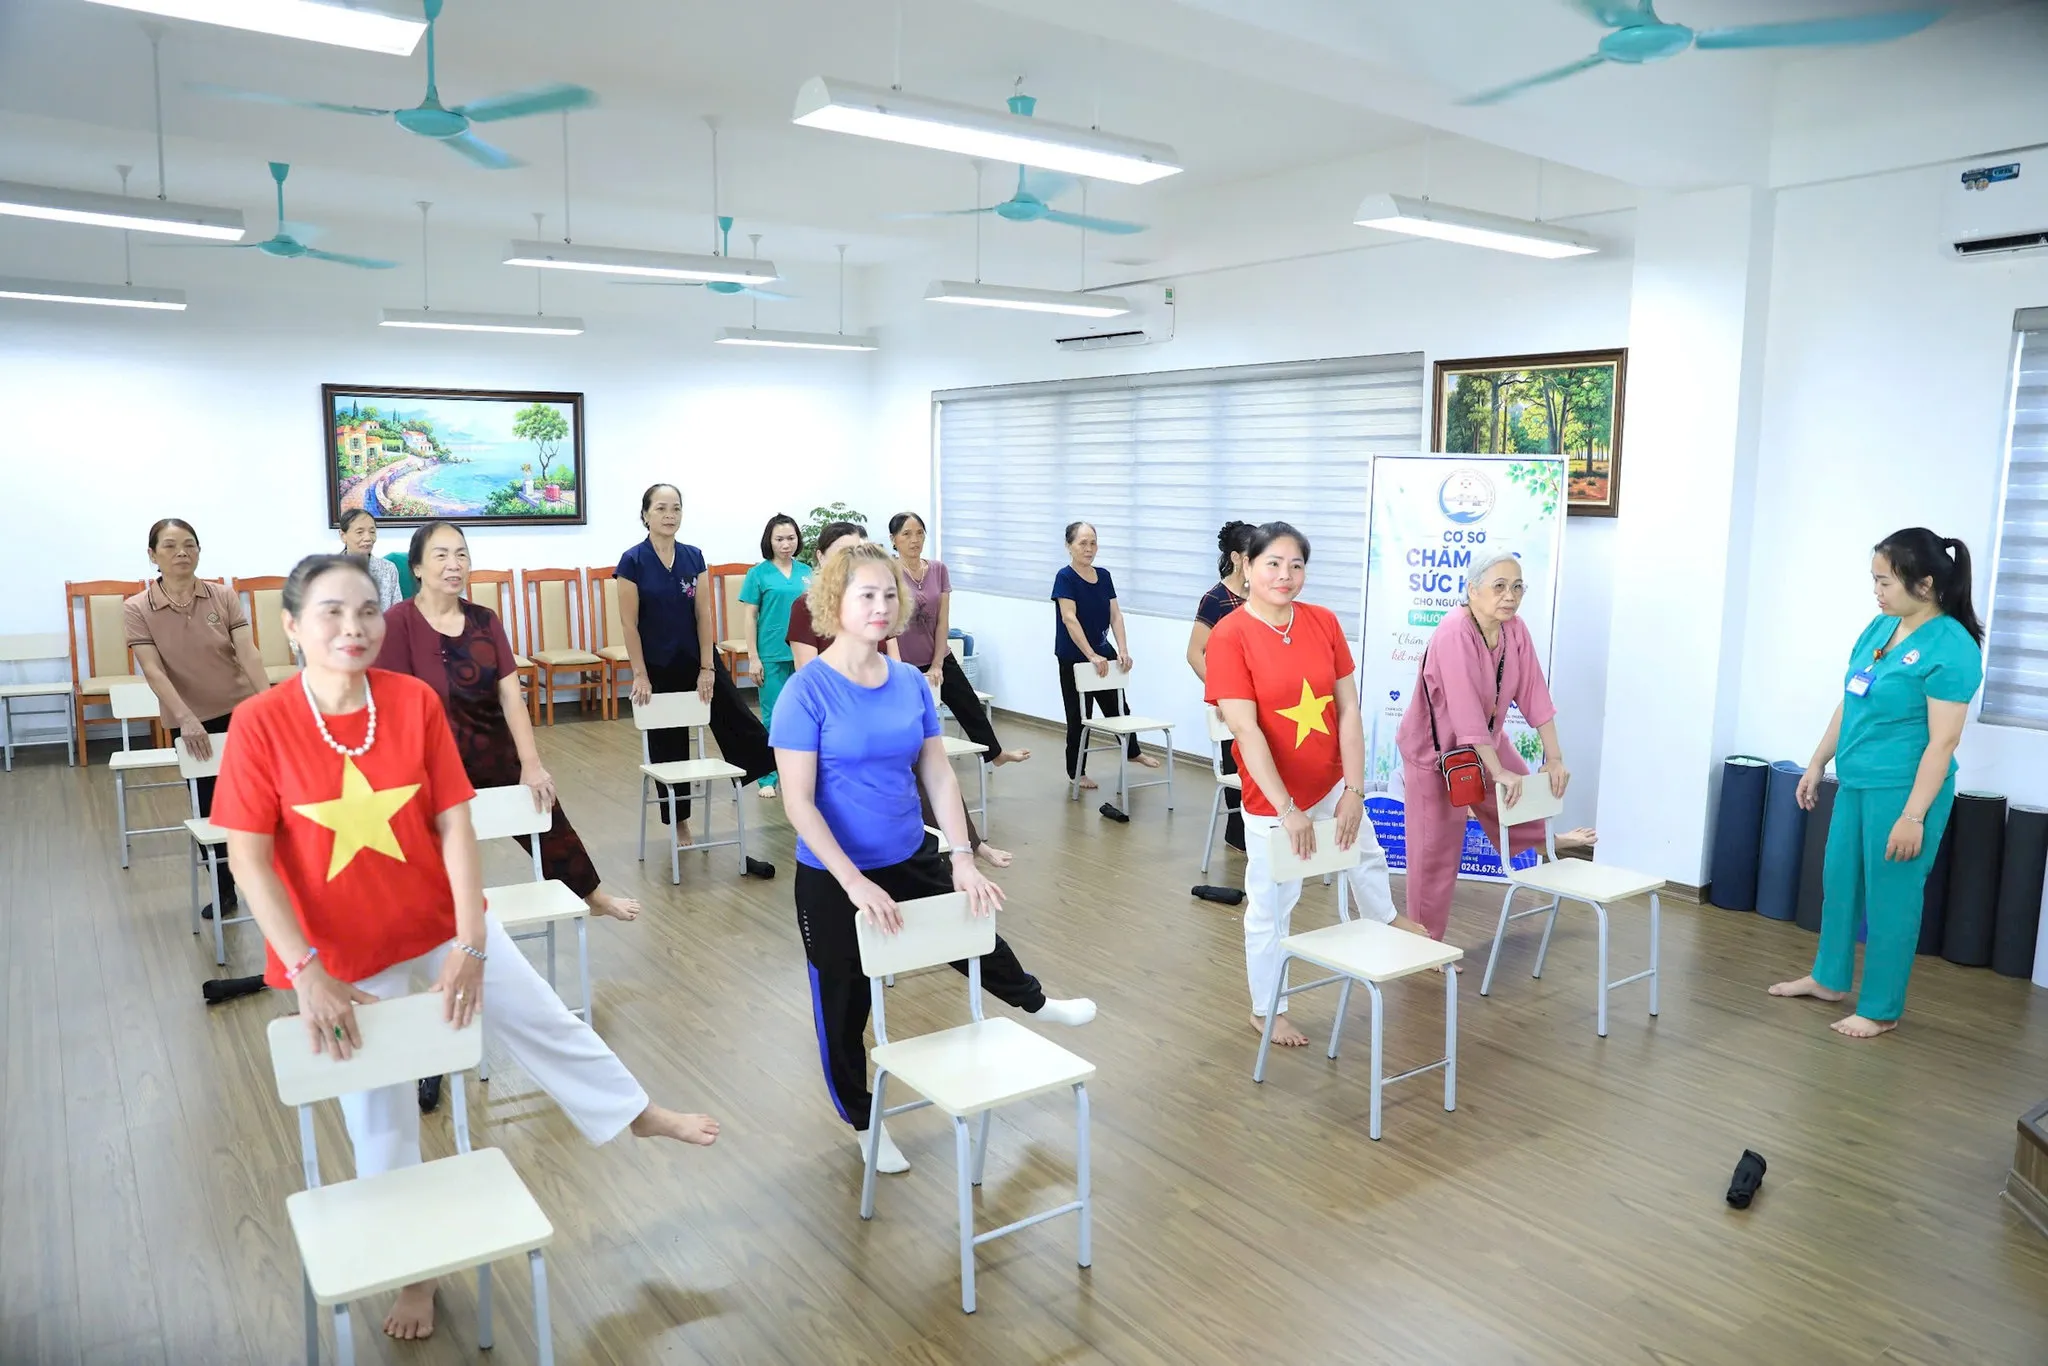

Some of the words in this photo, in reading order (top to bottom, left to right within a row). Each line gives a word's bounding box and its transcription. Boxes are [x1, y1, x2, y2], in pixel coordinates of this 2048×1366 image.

[1443, 530, 1464, 543] CƠ
[1467, 528, 1487, 543] SỞ
[1406, 545, 1471, 568] CHĂM
[1408, 569, 1452, 593] SỨC
[1413, 597, 1433, 606] CHO
